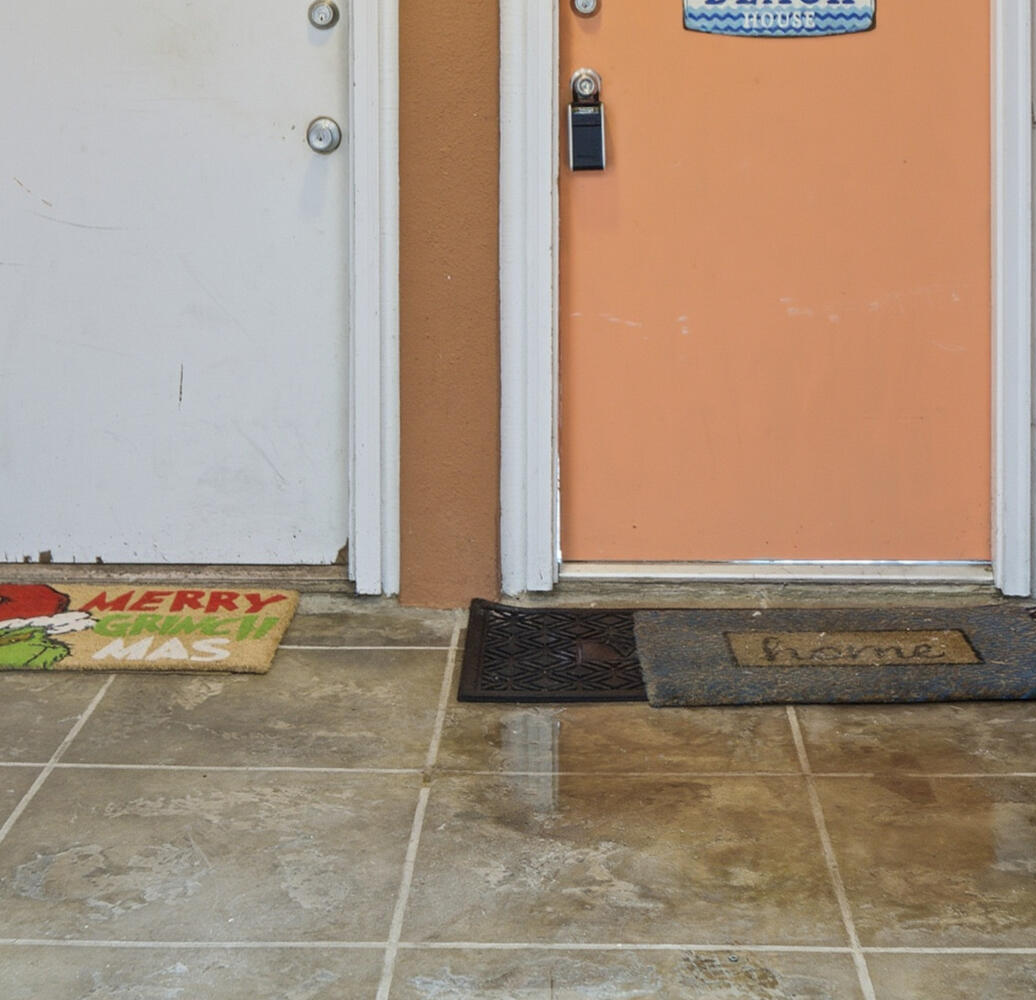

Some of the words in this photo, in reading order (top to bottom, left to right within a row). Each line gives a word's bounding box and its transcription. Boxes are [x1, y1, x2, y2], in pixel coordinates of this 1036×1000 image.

[743, 11, 815, 28] HOUSE
[78, 590, 287, 613] MERRY
[92, 613, 279, 640] GRINCH
[92, 636, 231, 662] MAS
[762, 636, 945, 661] home
